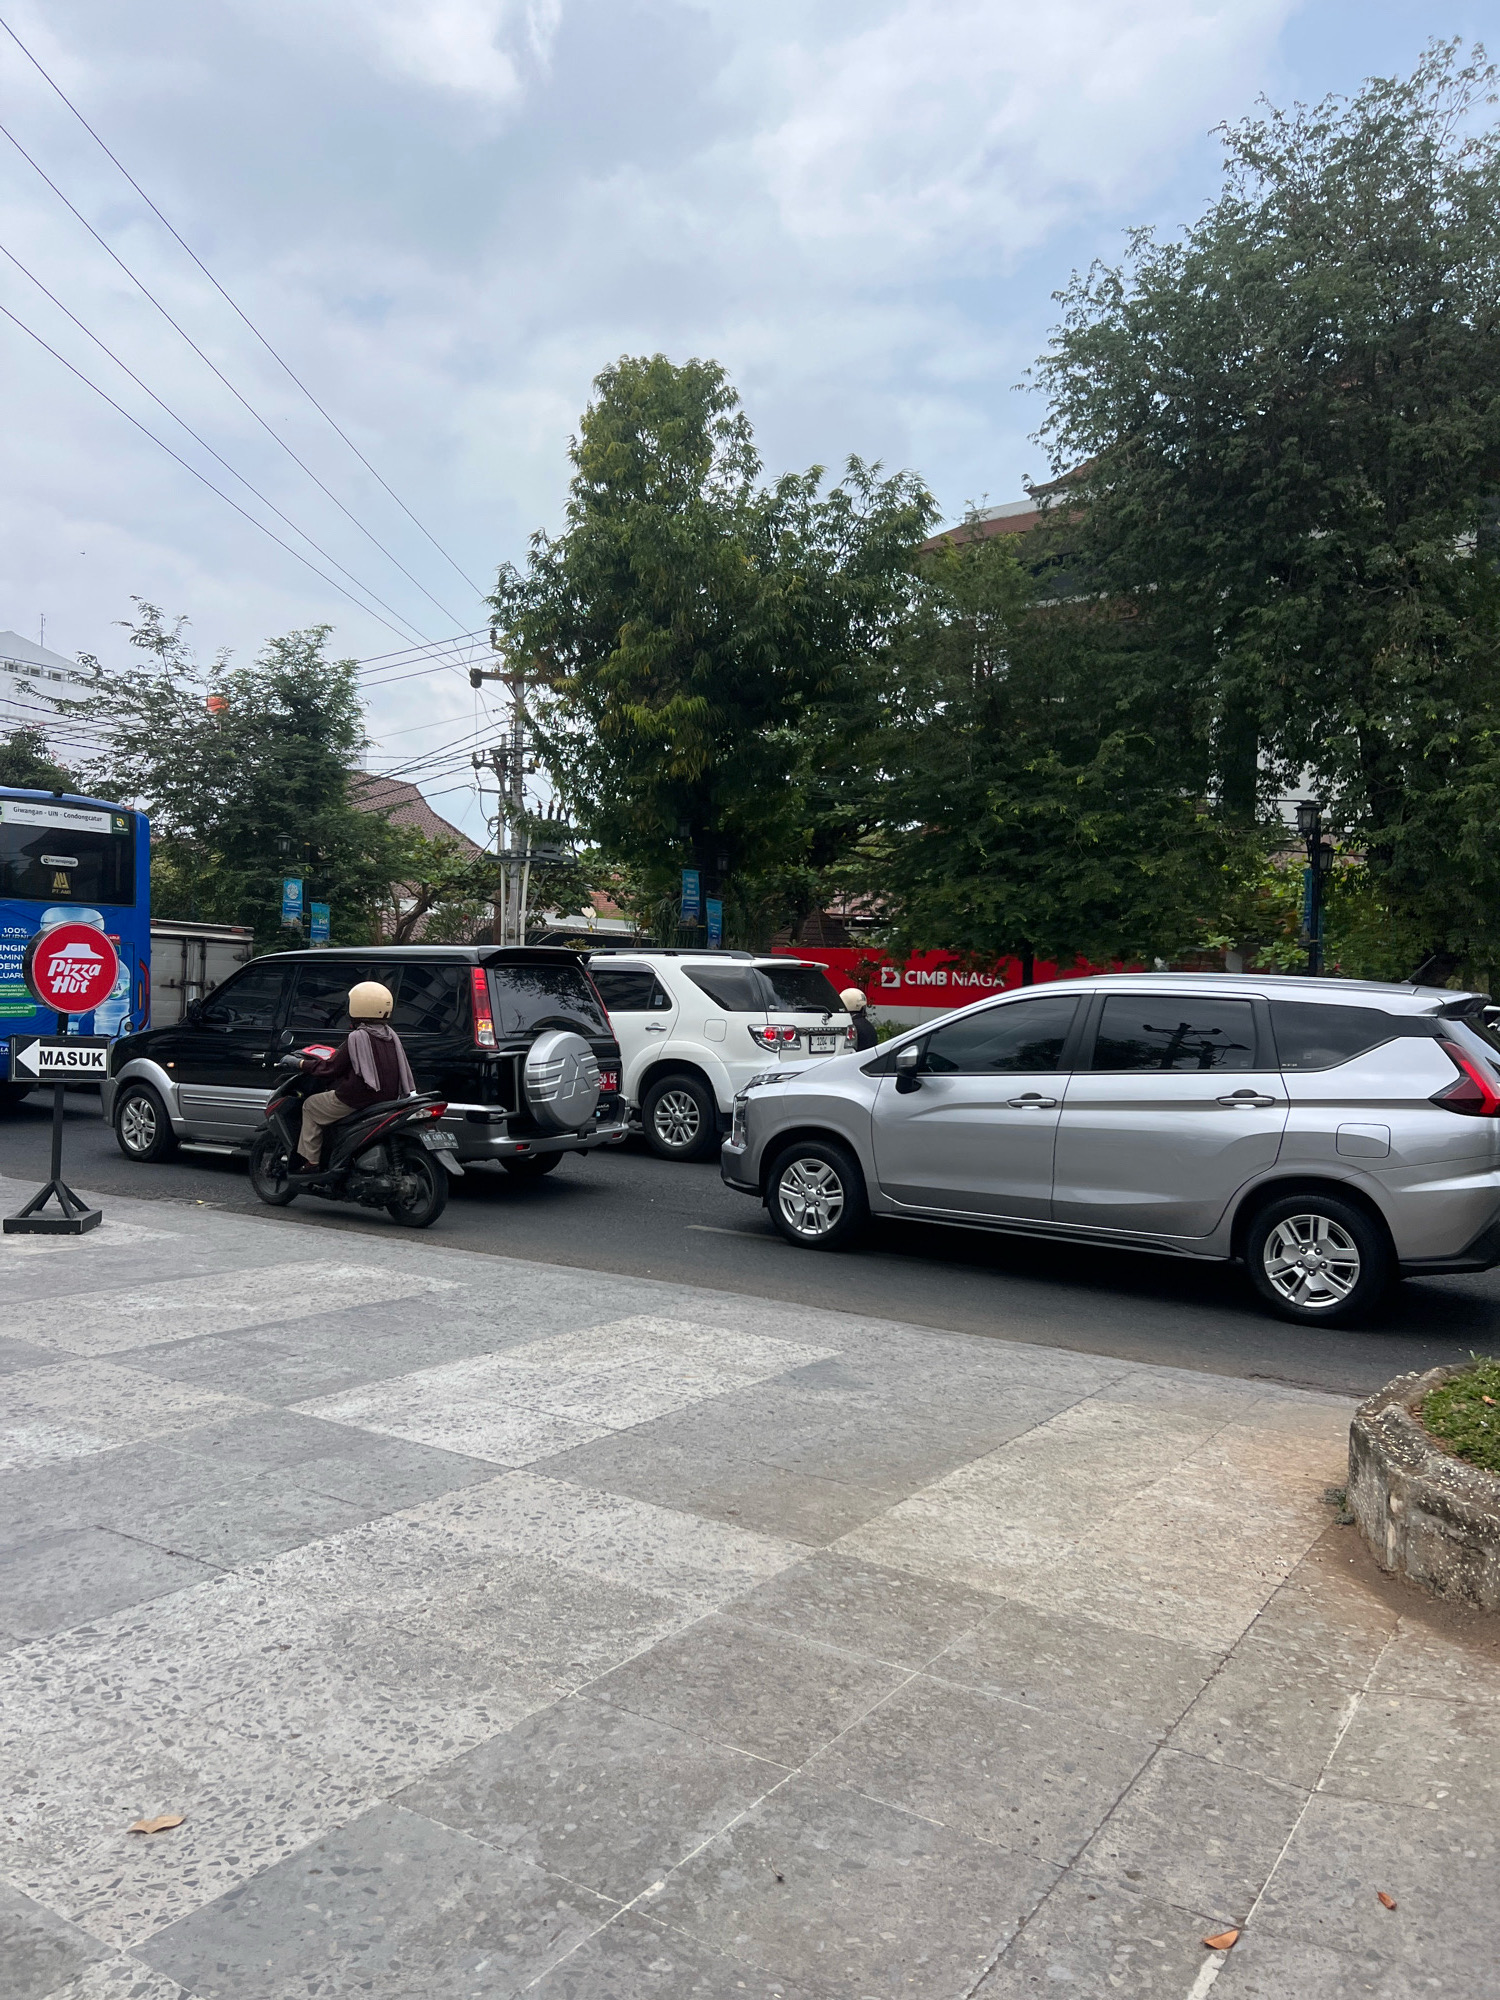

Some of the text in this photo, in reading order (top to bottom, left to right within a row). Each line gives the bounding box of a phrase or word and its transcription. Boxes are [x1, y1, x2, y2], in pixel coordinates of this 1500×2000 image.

[13, 806, 43, 816] Giwangan
[64, 812, 102, 821] Condongcatur
[48, 959, 102, 980] Pizza
[51, 976, 90, 993] Hut
[905, 970, 1005, 987] CIMB NIAGA
[39, 1051, 103, 1067] MASUK
[610, 1073, 617, 1083] CE
